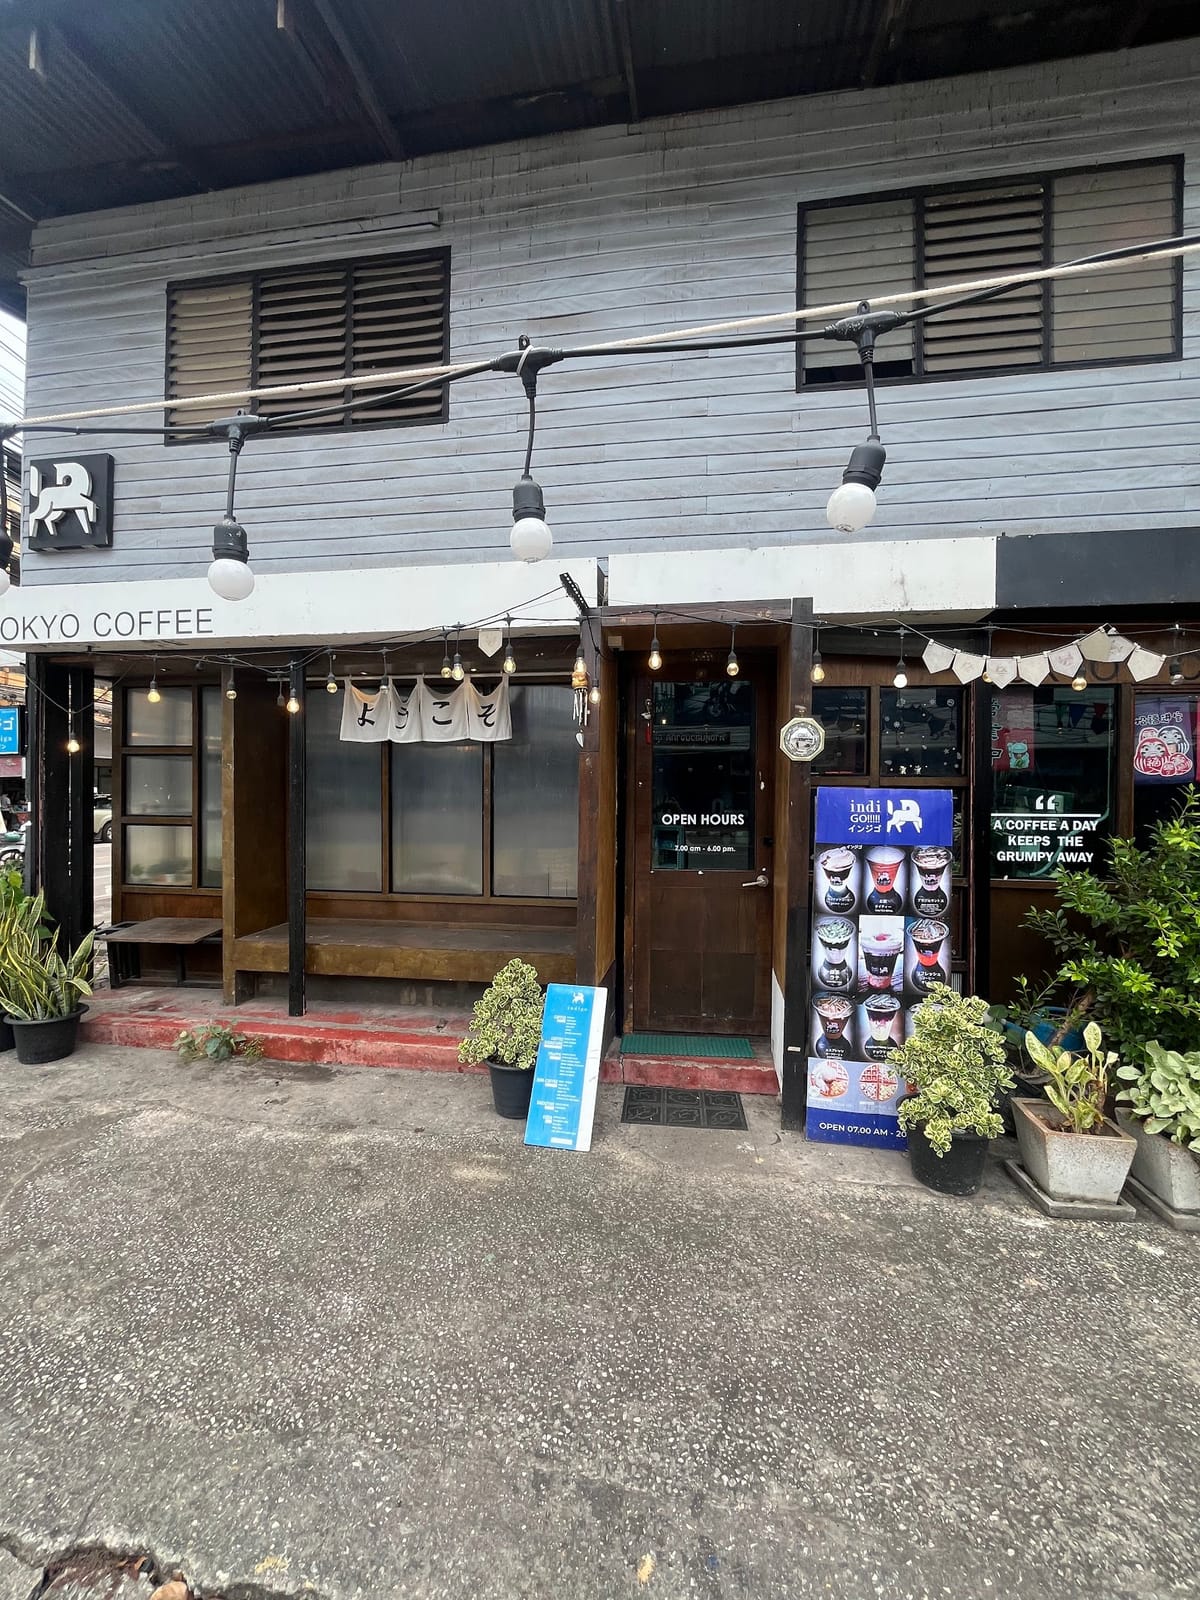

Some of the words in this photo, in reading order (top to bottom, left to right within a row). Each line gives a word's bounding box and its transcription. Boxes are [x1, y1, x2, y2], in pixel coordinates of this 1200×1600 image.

[0, 613, 80, 641] OKYO
[93, 608, 214, 637] COFFEE
[357, 699, 496, 730] ようこそ
[850, 799, 882, 813] indi
[661, 813, 697, 825] OPEN
[700, 813, 745, 826] HOURS
[993, 819, 1003, 831] A
[1006, 819, 1057, 831] COFFEE
[1059, 820, 1070, 832] A
[1072, 820, 1099, 832] DAY
[848, 824, 882, 833] インジゴ
[1007, 835, 1051, 847] KEEPS
[1057, 836, 1084, 847] THE
[707, 844, 722, 852] 6.00
[996, 851, 1054, 863] GRUMPY
[1056, 852, 1094, 863] AWAY
[819, 1122, 845, 1132] OPEN
[847, 1125, 872, 1135] 07.00
[873, 1128, 888, 1136] AM
